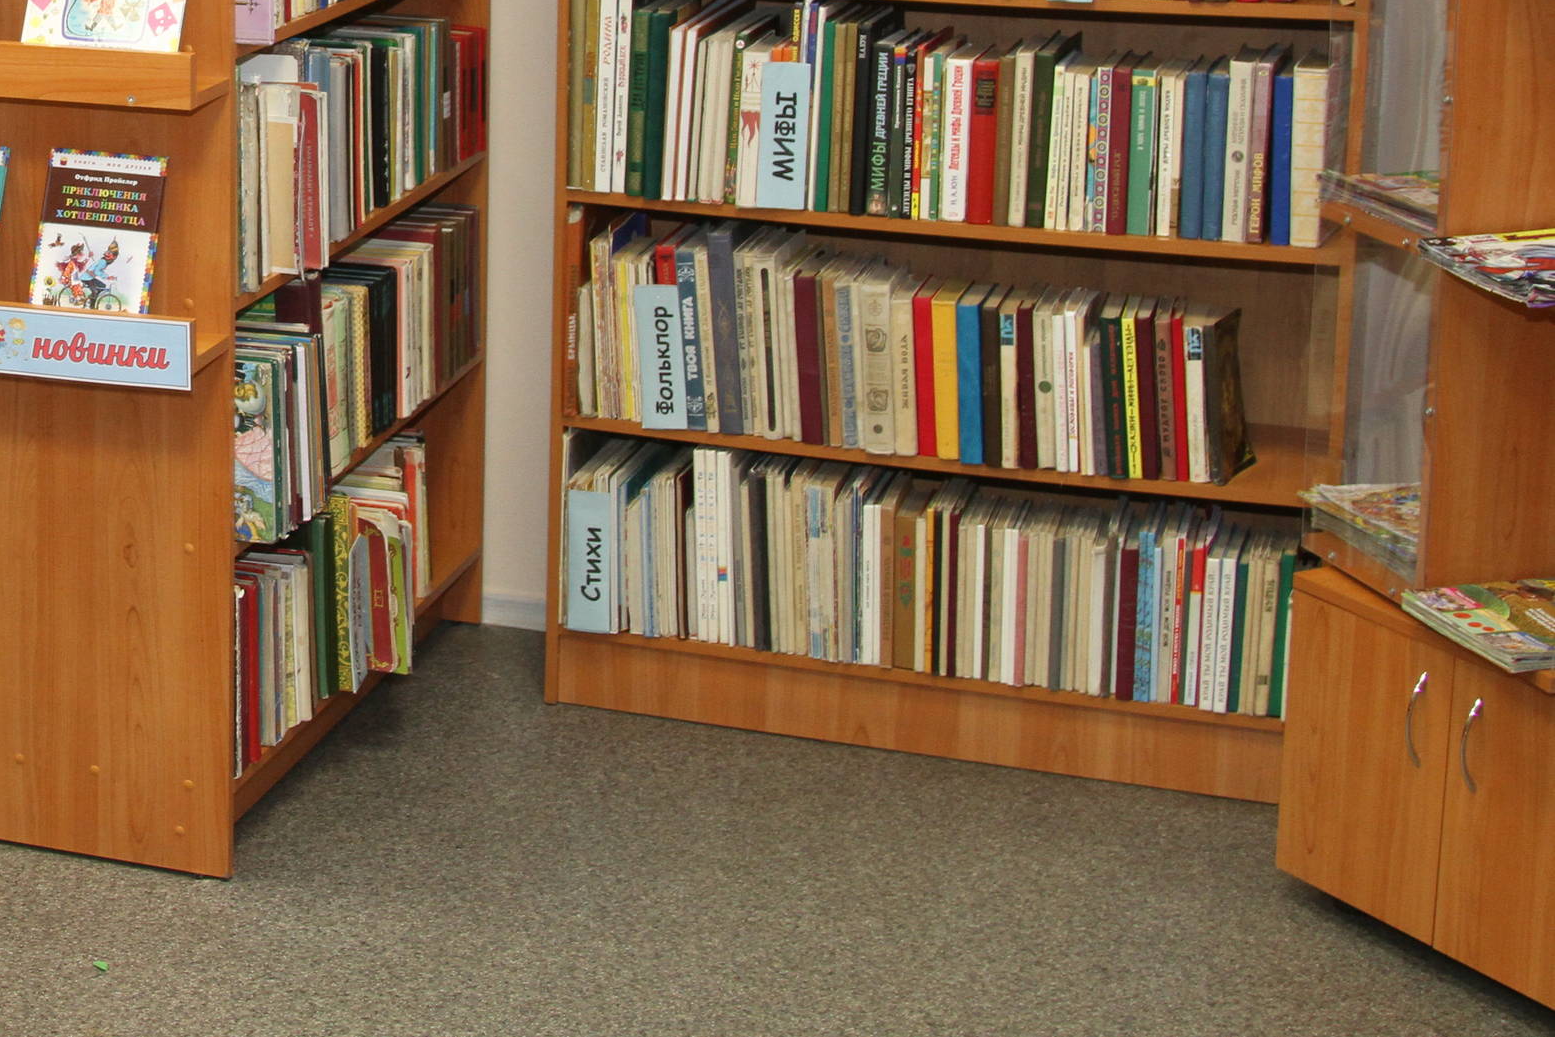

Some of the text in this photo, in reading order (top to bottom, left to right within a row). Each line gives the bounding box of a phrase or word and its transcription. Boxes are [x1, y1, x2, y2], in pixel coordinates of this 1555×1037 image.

[602, 15, 612, 65] РОДИНА
[905, 77, 914, 105] ЕГИПТА
[952, 65, 964, 88] Греции
[950, 90, 963, 116] Древней
[773, 91, 798, 181] МИФЫ
[870, 52, 889, 191] МИФЫ ДРЕВНЕЙ ГРЕЦИИ
[904, 107, 913, 144] ДРЕВНЕГО
[950, 117, 961, 137] мифы
[903, 147, 912, 171] МИФЫ
[948, 144, 960, 171] Легенды
[61, 185, 147, 201] ПРИКЛЮЧЕНИЯ
[65, 198, 139, 213] РАЗБОЙНИКА
[902, 179, 911, 215] ЛЕГЕНДЫ
[1249, 152, 1263, 234] ГЕРОИ МИФОВ
[55, 209, 145, 226] ХОТЦЕНПЛОТЦА
[32, 331, 170, 370] новинки
[683, 296, 698, 381] ТВОЯ КНИГА
[654, 306, 674, 415] Фольклор
[580, 527, 602, 602] Стихи
